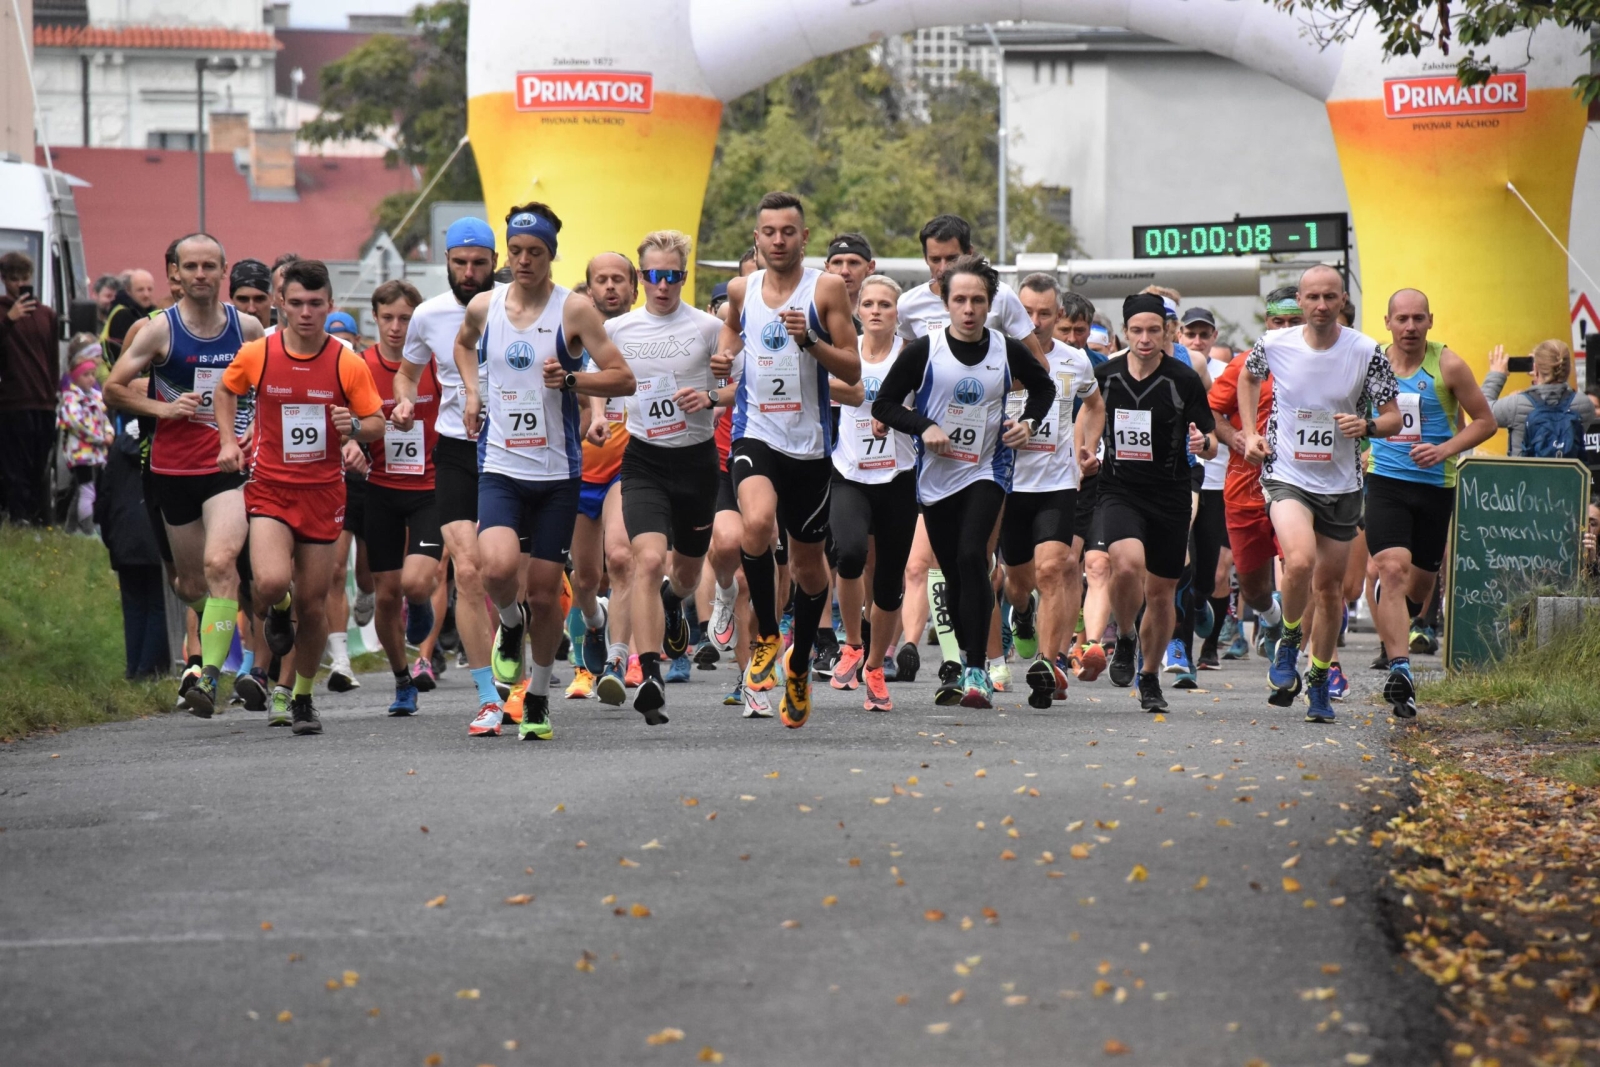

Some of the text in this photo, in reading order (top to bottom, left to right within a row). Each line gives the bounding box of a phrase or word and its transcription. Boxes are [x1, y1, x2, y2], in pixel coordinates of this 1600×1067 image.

[594, 58, 614, 66] 1872
[522, 76, 645, 106] PRIMATOR
[1412, 118, 1500, 130] PIVOVAR NÁCHOD
[1145, 224, 1271, 256] 00:00:08
[772, 378, 786, 396] 2
[202, 391, 213, 407] 6
[648, 398, 675, 419] 40
[508, 413, 537, 431] 79
[1402, 413, 1413, 428] 0
[290, 428, 318, 445] 99
[950, 428, 976, 446] 49
[1031, 422, 1051, 438] 4
[1116, 430, 1151, 446] 138
[1296, 429, 1333, 446] 146
[392, 442, 417, 457] 76
[862, 437, 887, 455] 77
[1456, 554, 1480, 572] na
